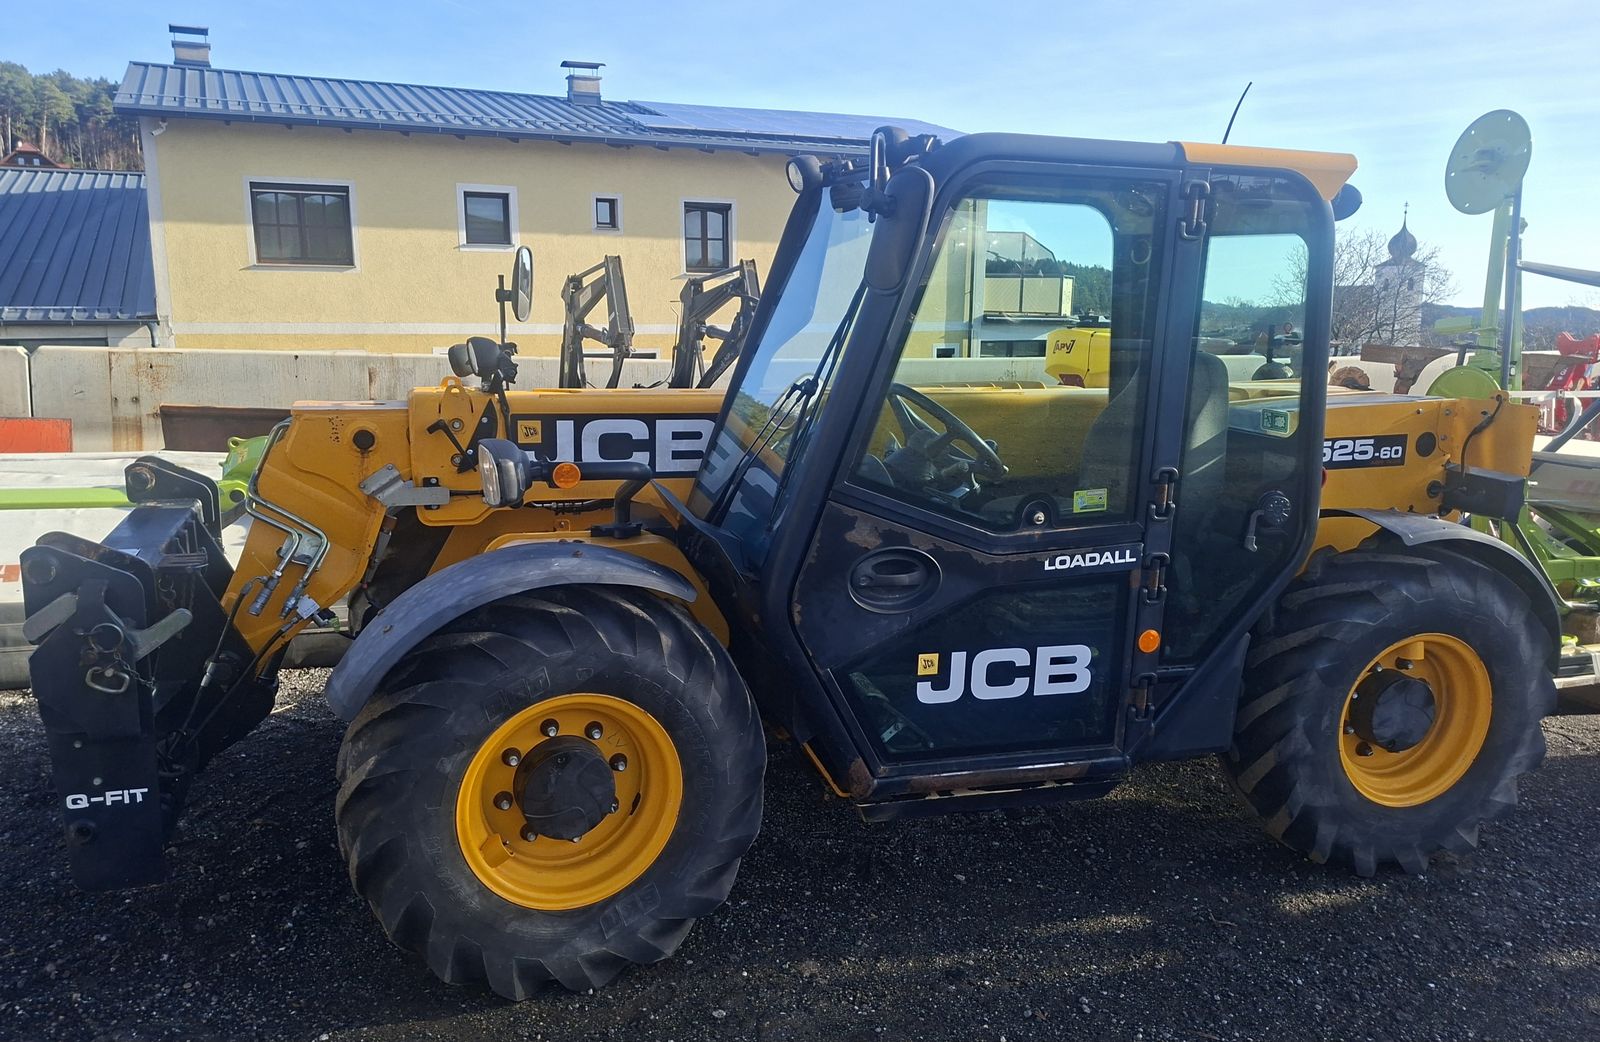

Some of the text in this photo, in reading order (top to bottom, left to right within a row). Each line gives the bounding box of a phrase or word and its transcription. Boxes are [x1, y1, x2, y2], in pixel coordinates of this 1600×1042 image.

[524, 418, 716, 473] JCB
[1044, 549, 1137, 571] LOADALL
[916, 644, 1092, 704] JCB
[66, 788, 149, 810] Q-FIT
